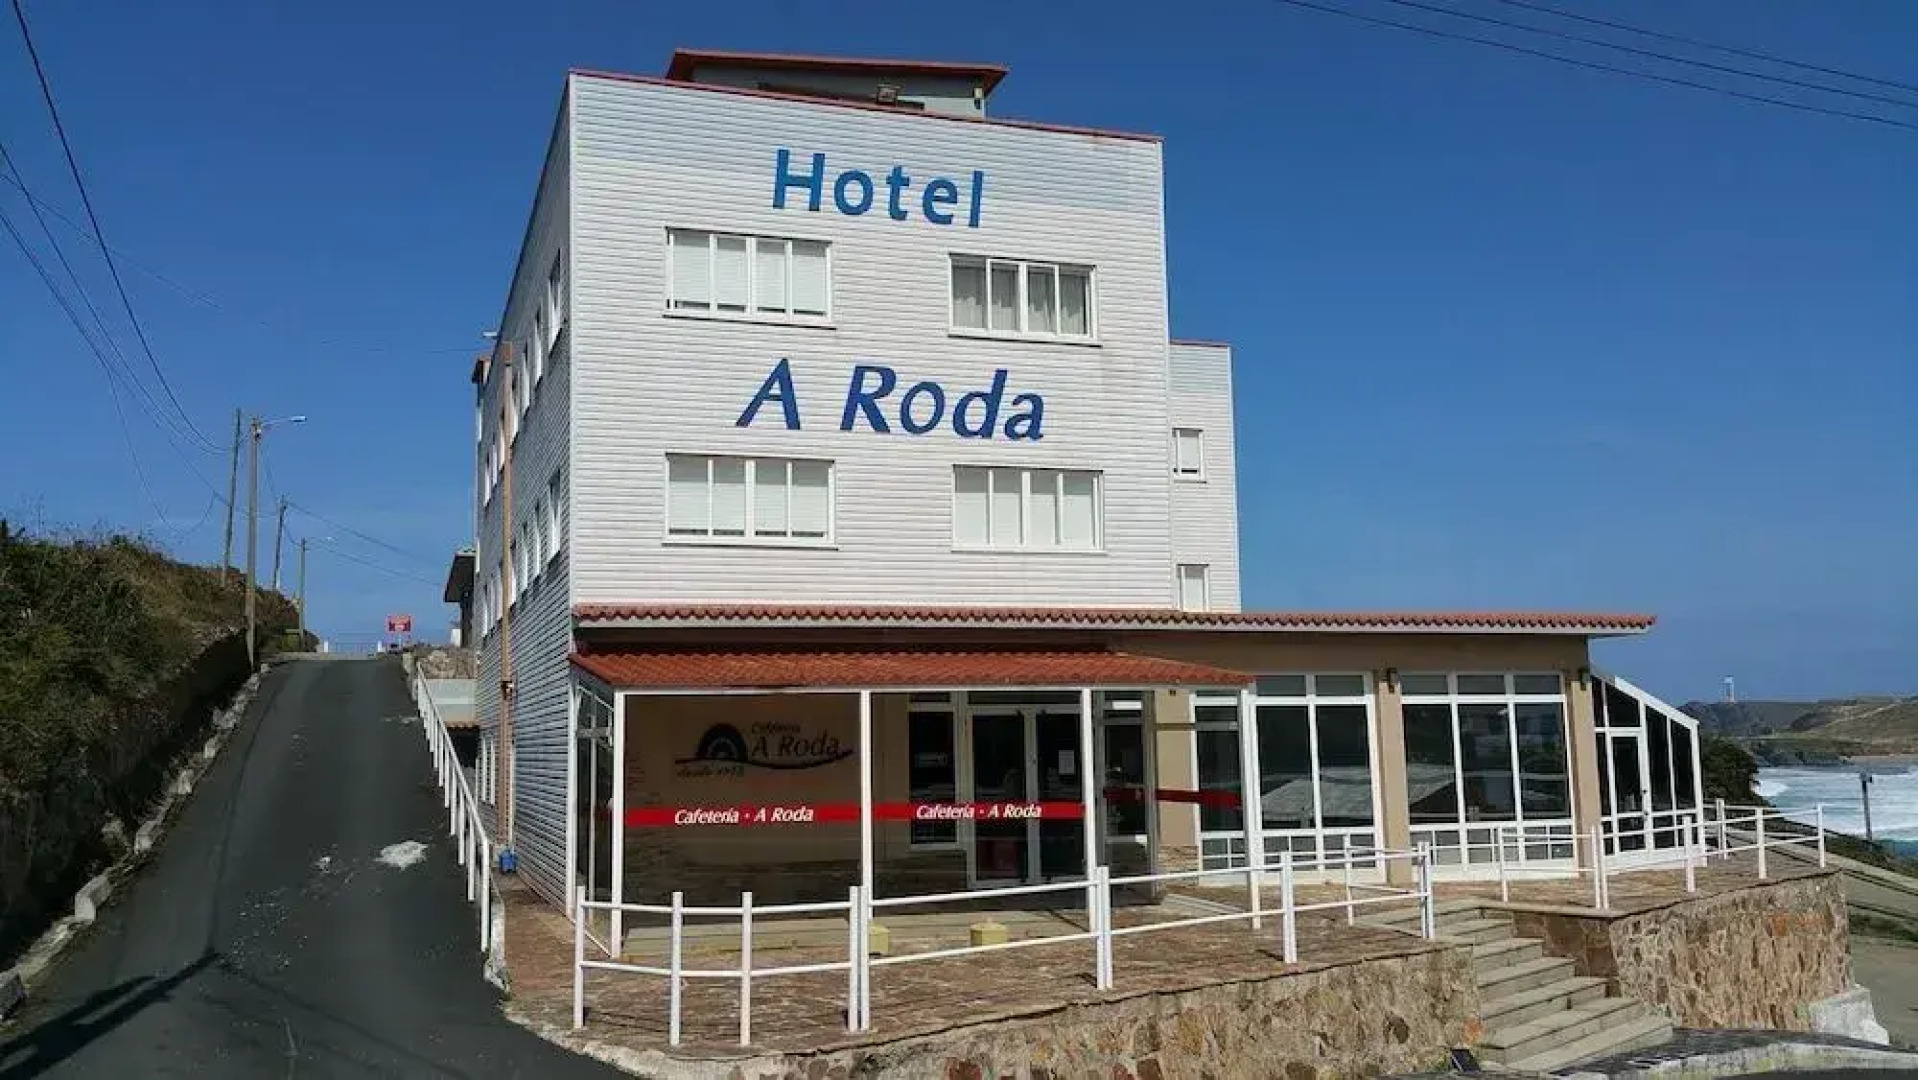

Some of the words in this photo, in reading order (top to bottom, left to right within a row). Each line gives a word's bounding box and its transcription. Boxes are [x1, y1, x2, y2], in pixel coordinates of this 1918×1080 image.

[773, 149, 984, 228] Hotel
[735, 357, 801, 431] A
[839, 365, 1045, 441] Roda
[751, 736, 769, 757] A
[780, 728, 839, 757] Roda
[674, 808, 739, 824] Cafetería
[754, 807, 766, 822] A
[771, 806, 814, 822] Roda
[916, 803, 975, 820] Cafetería
[987, 804, 999, 818] A
[1002, 804, 1042, 818] Roda
